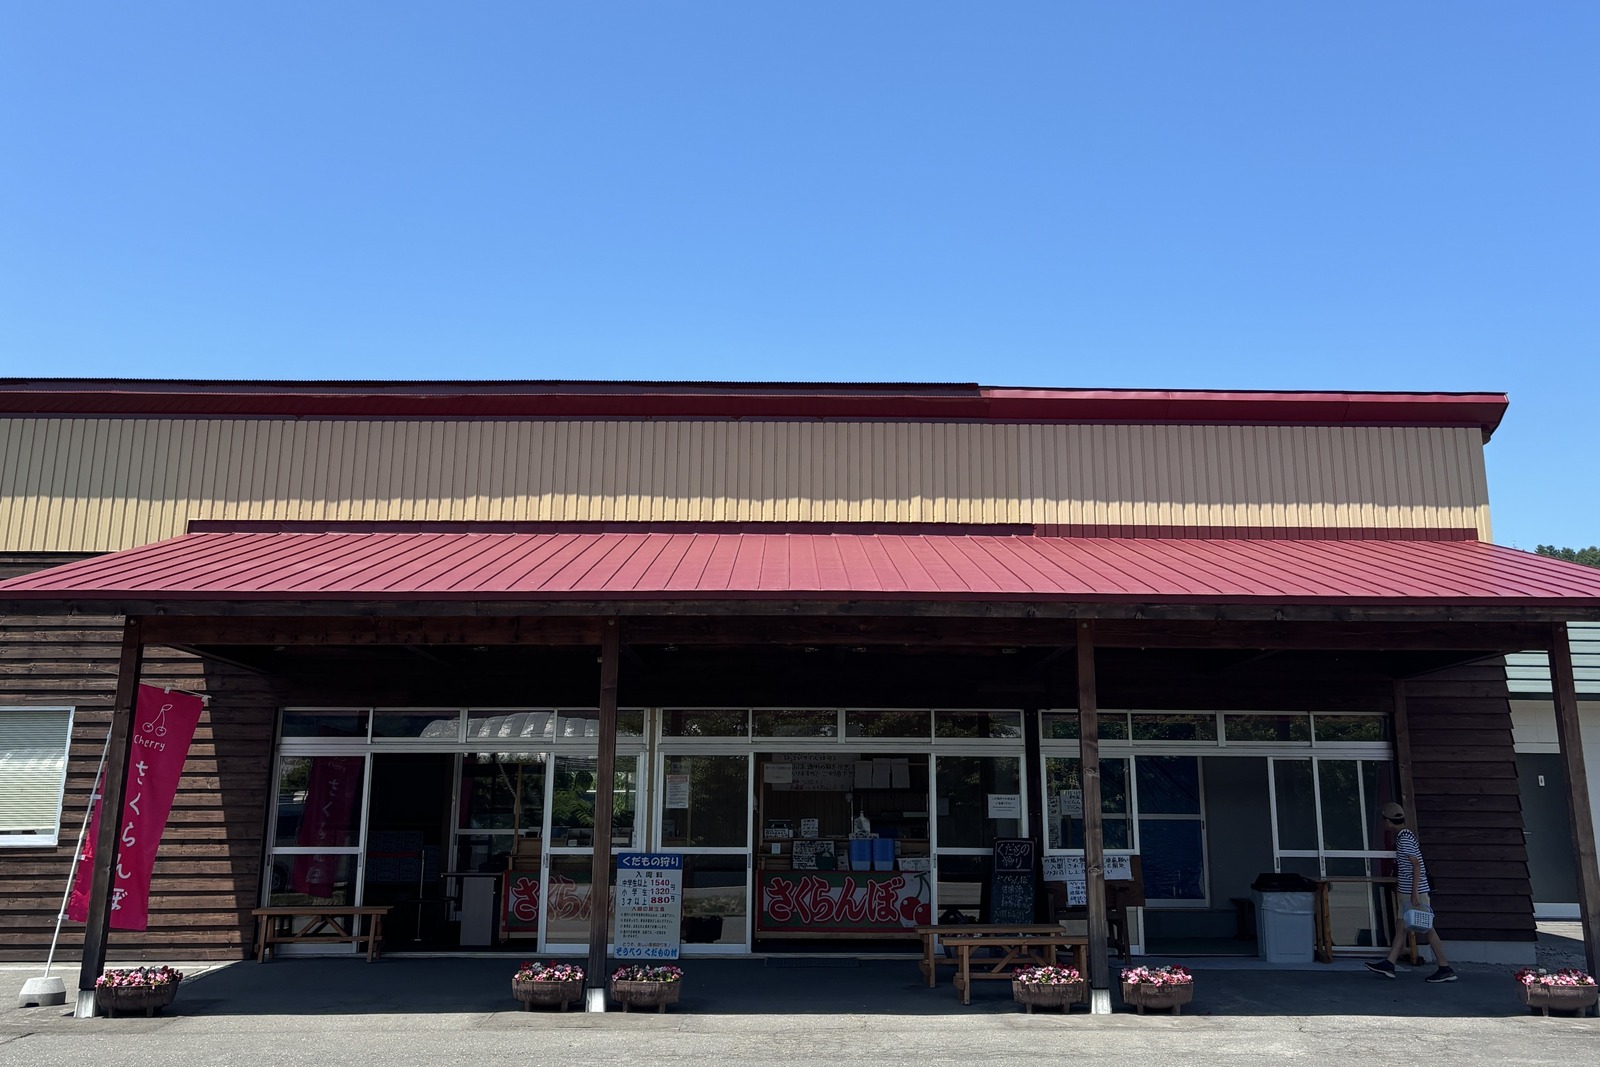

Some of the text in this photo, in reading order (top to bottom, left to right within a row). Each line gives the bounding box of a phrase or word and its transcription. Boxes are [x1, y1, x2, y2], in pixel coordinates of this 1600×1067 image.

[133, 734, 166, 752] Cherry
[997, 843, 1030, 857] くだもの
[622, 856, 679, 867] くだもの狩り
[650, 896, 670, 904] 880
[765, 875, 905, 924] さくらんぼ
